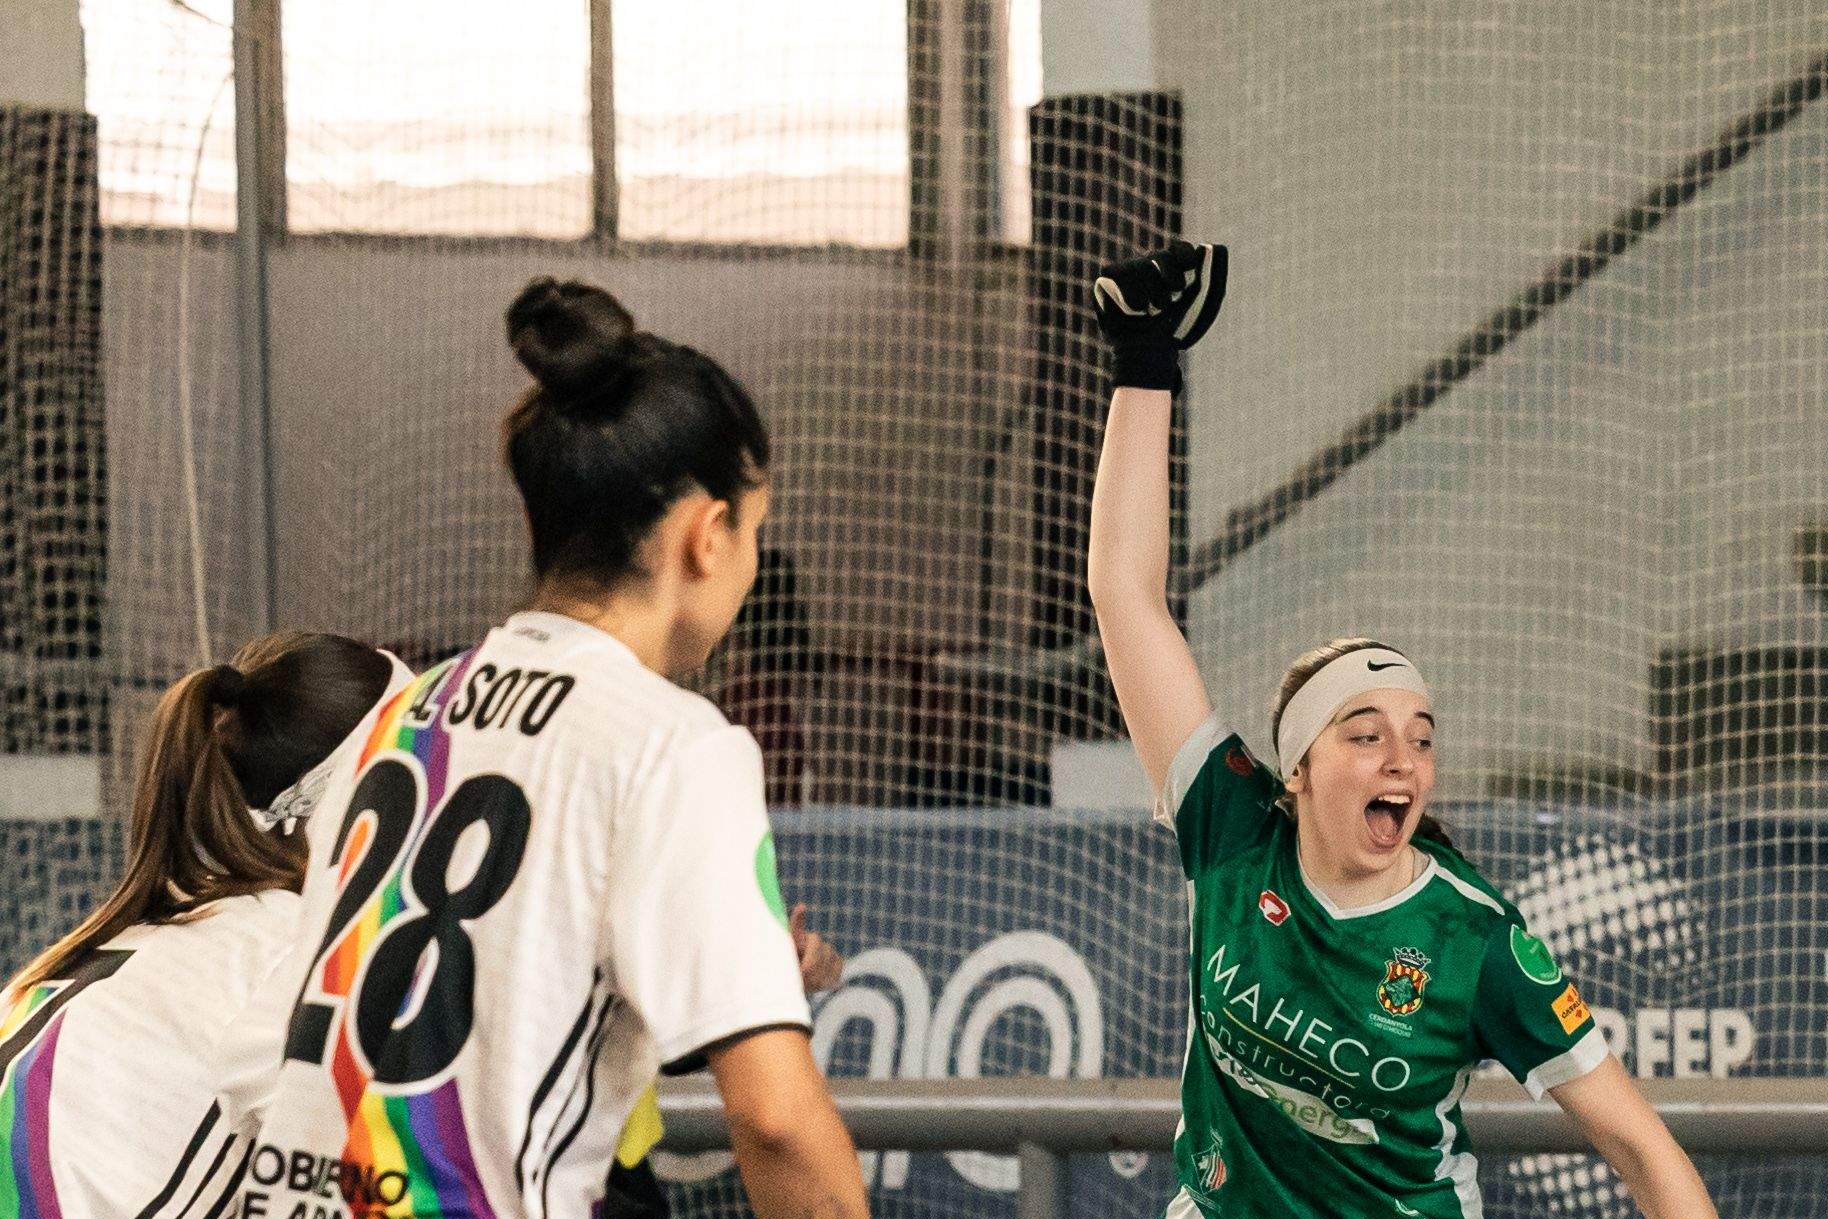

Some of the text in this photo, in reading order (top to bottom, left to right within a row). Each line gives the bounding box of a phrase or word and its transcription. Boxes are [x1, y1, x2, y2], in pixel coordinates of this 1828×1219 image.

[448, 663, 576, 737] SOTO
[284, 755, 533, 1086] 28
[1206, 943, 1412, 1093] MAHECO
[250, 1144, 411, 1207] OBIERNO
